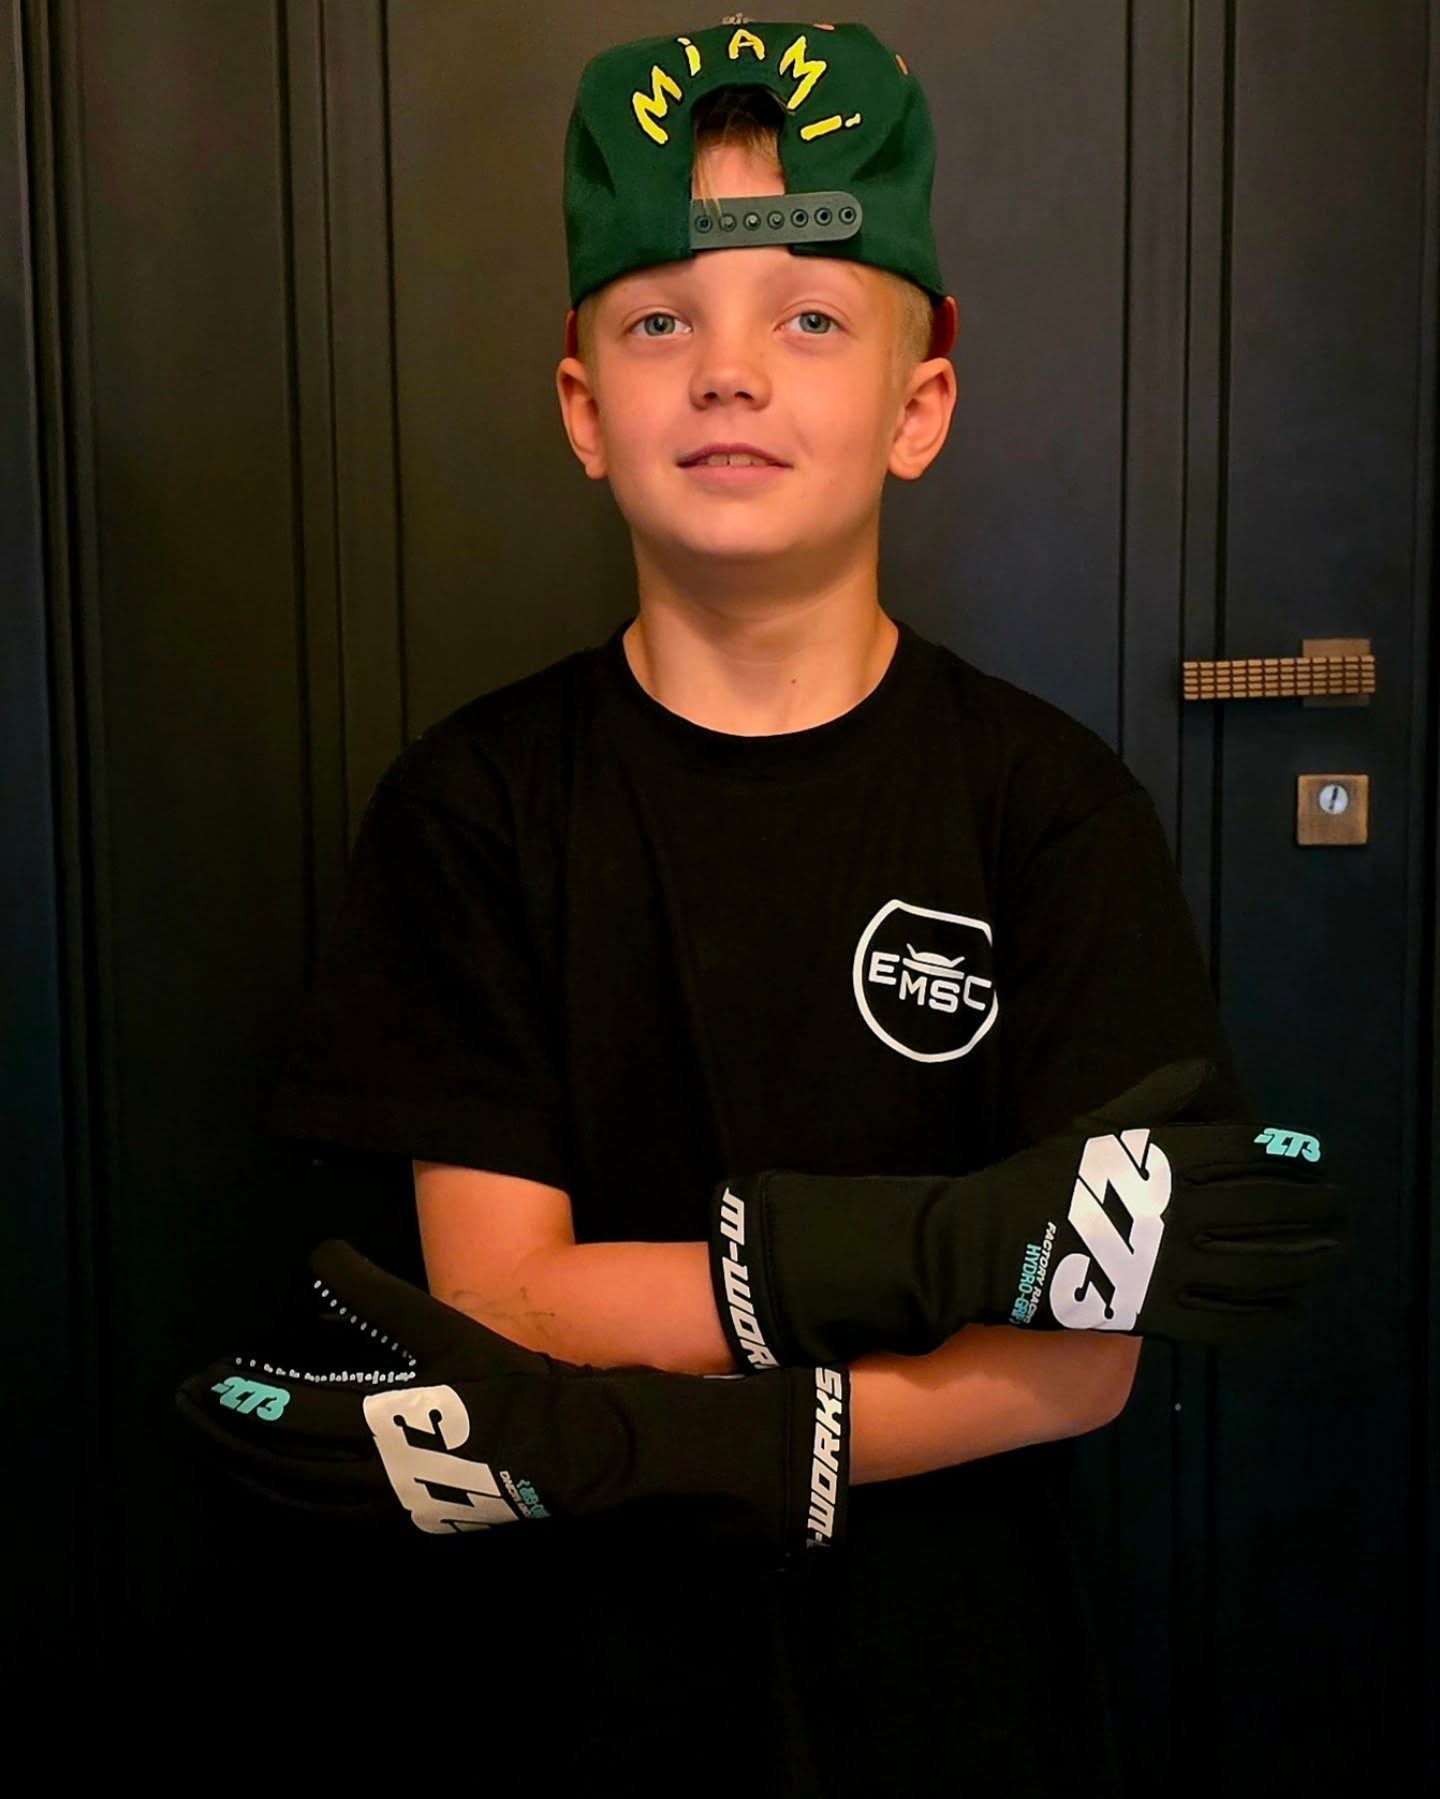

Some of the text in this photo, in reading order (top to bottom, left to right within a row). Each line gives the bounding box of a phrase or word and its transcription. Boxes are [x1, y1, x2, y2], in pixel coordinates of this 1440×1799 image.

[868, 951, 993, 1013] EMSC
[720, 1187, 781, 1370] M-WOR
[1036, 1221, 1057, 1287] FACTORY
